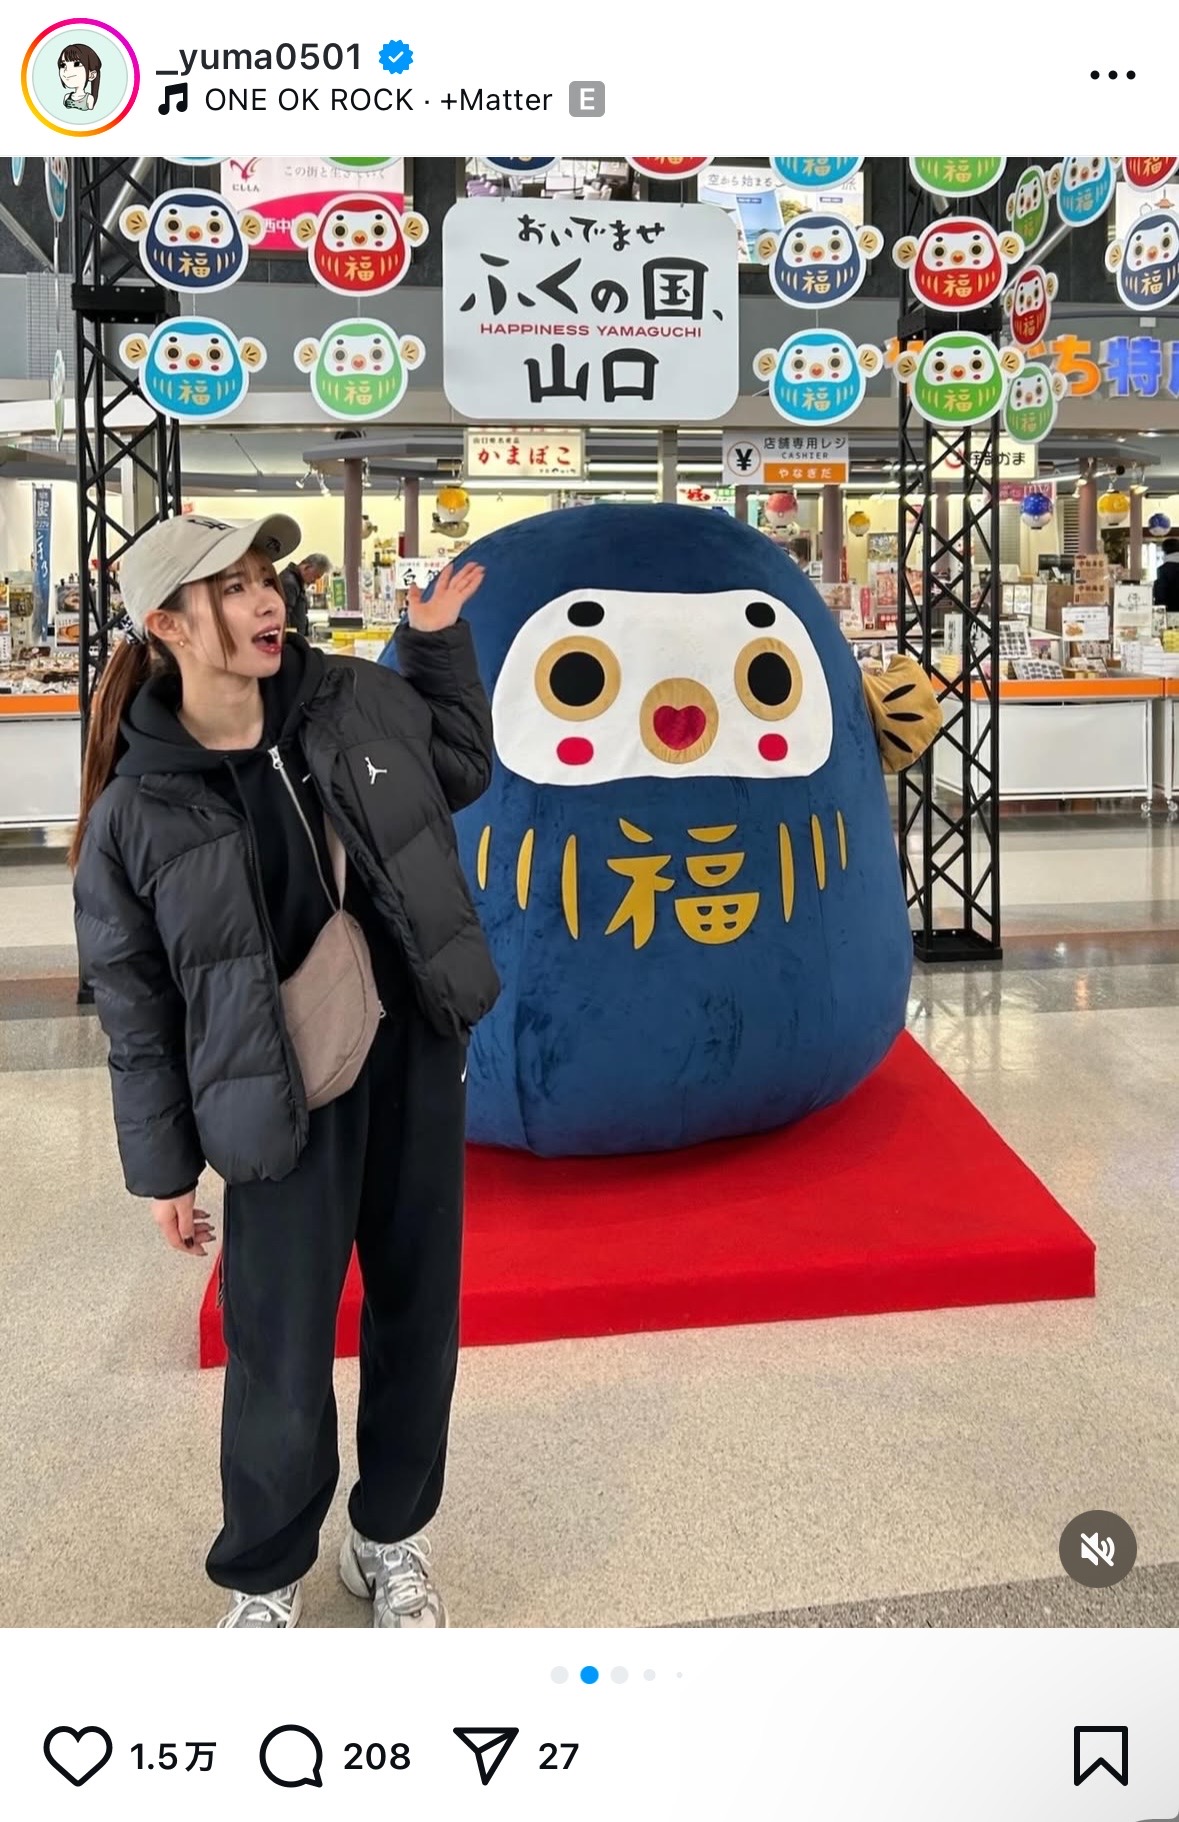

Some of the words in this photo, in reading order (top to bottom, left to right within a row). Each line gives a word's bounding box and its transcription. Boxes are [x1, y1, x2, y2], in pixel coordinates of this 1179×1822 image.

[708, 174, 773, 187] 空から始まる
[943, 160, 972, 183] 福
[232, 184, 260, 192] にししん
[264, 217, 293, 234] 西中
[518, 214, 665, 251] おいでませ
[178, 252, 211, 278] 福
[344, 255, 375, 282] 福
[460, 253, 723, 322] ふくの国、
[802, 270, 831, 295] 福
[943, 274, 972, 298] 福
[1141, 270, 1163, 296] 福
[480, 323, 590, 336] HAPPINESS
[596, 325, 702, 338] YAMAGUCHI
[523, 343, 660, 403] 山口
[178, 379, 211, 405] 福
[345, 380, 373, 405] 福
[802, 387, 831, 412] 福
[943, 389, 973, 413] 福
[478, 445, 571, 466] かまぼこ
[763, 437, 847, 450] 店舗専用レジ
[781, 451, 829, 460] CASHIER
[778, 468, 833, 480] やなぎだ
[604, 816, 760, 951] 福
